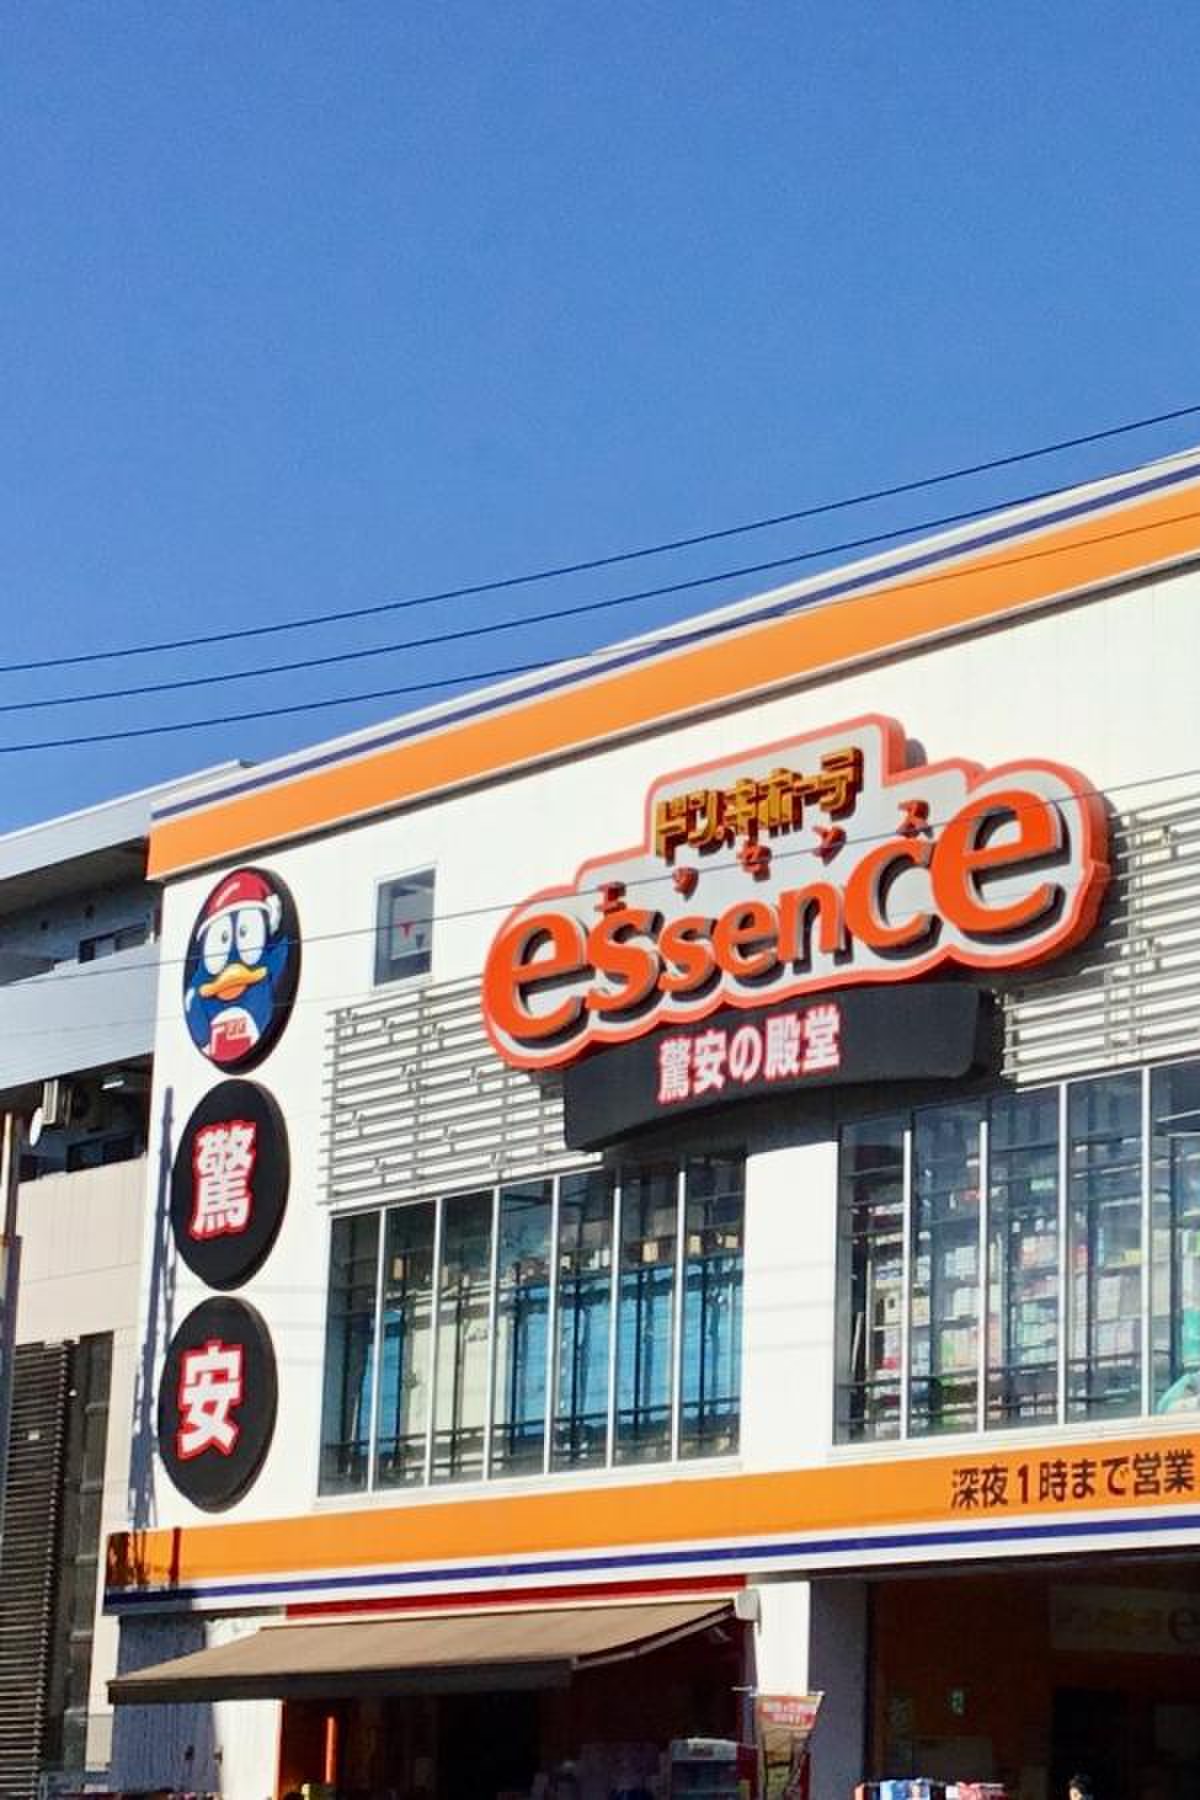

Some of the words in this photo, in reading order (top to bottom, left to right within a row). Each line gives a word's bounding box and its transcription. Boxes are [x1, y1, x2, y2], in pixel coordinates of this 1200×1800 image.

[494, 788, 1066, 1042] essence
[658, 1003, 842, 1104] 驚安の殿堂
[192, 1121, 257, 1237] 驚
[178, 1341, 243, 1459] 安
